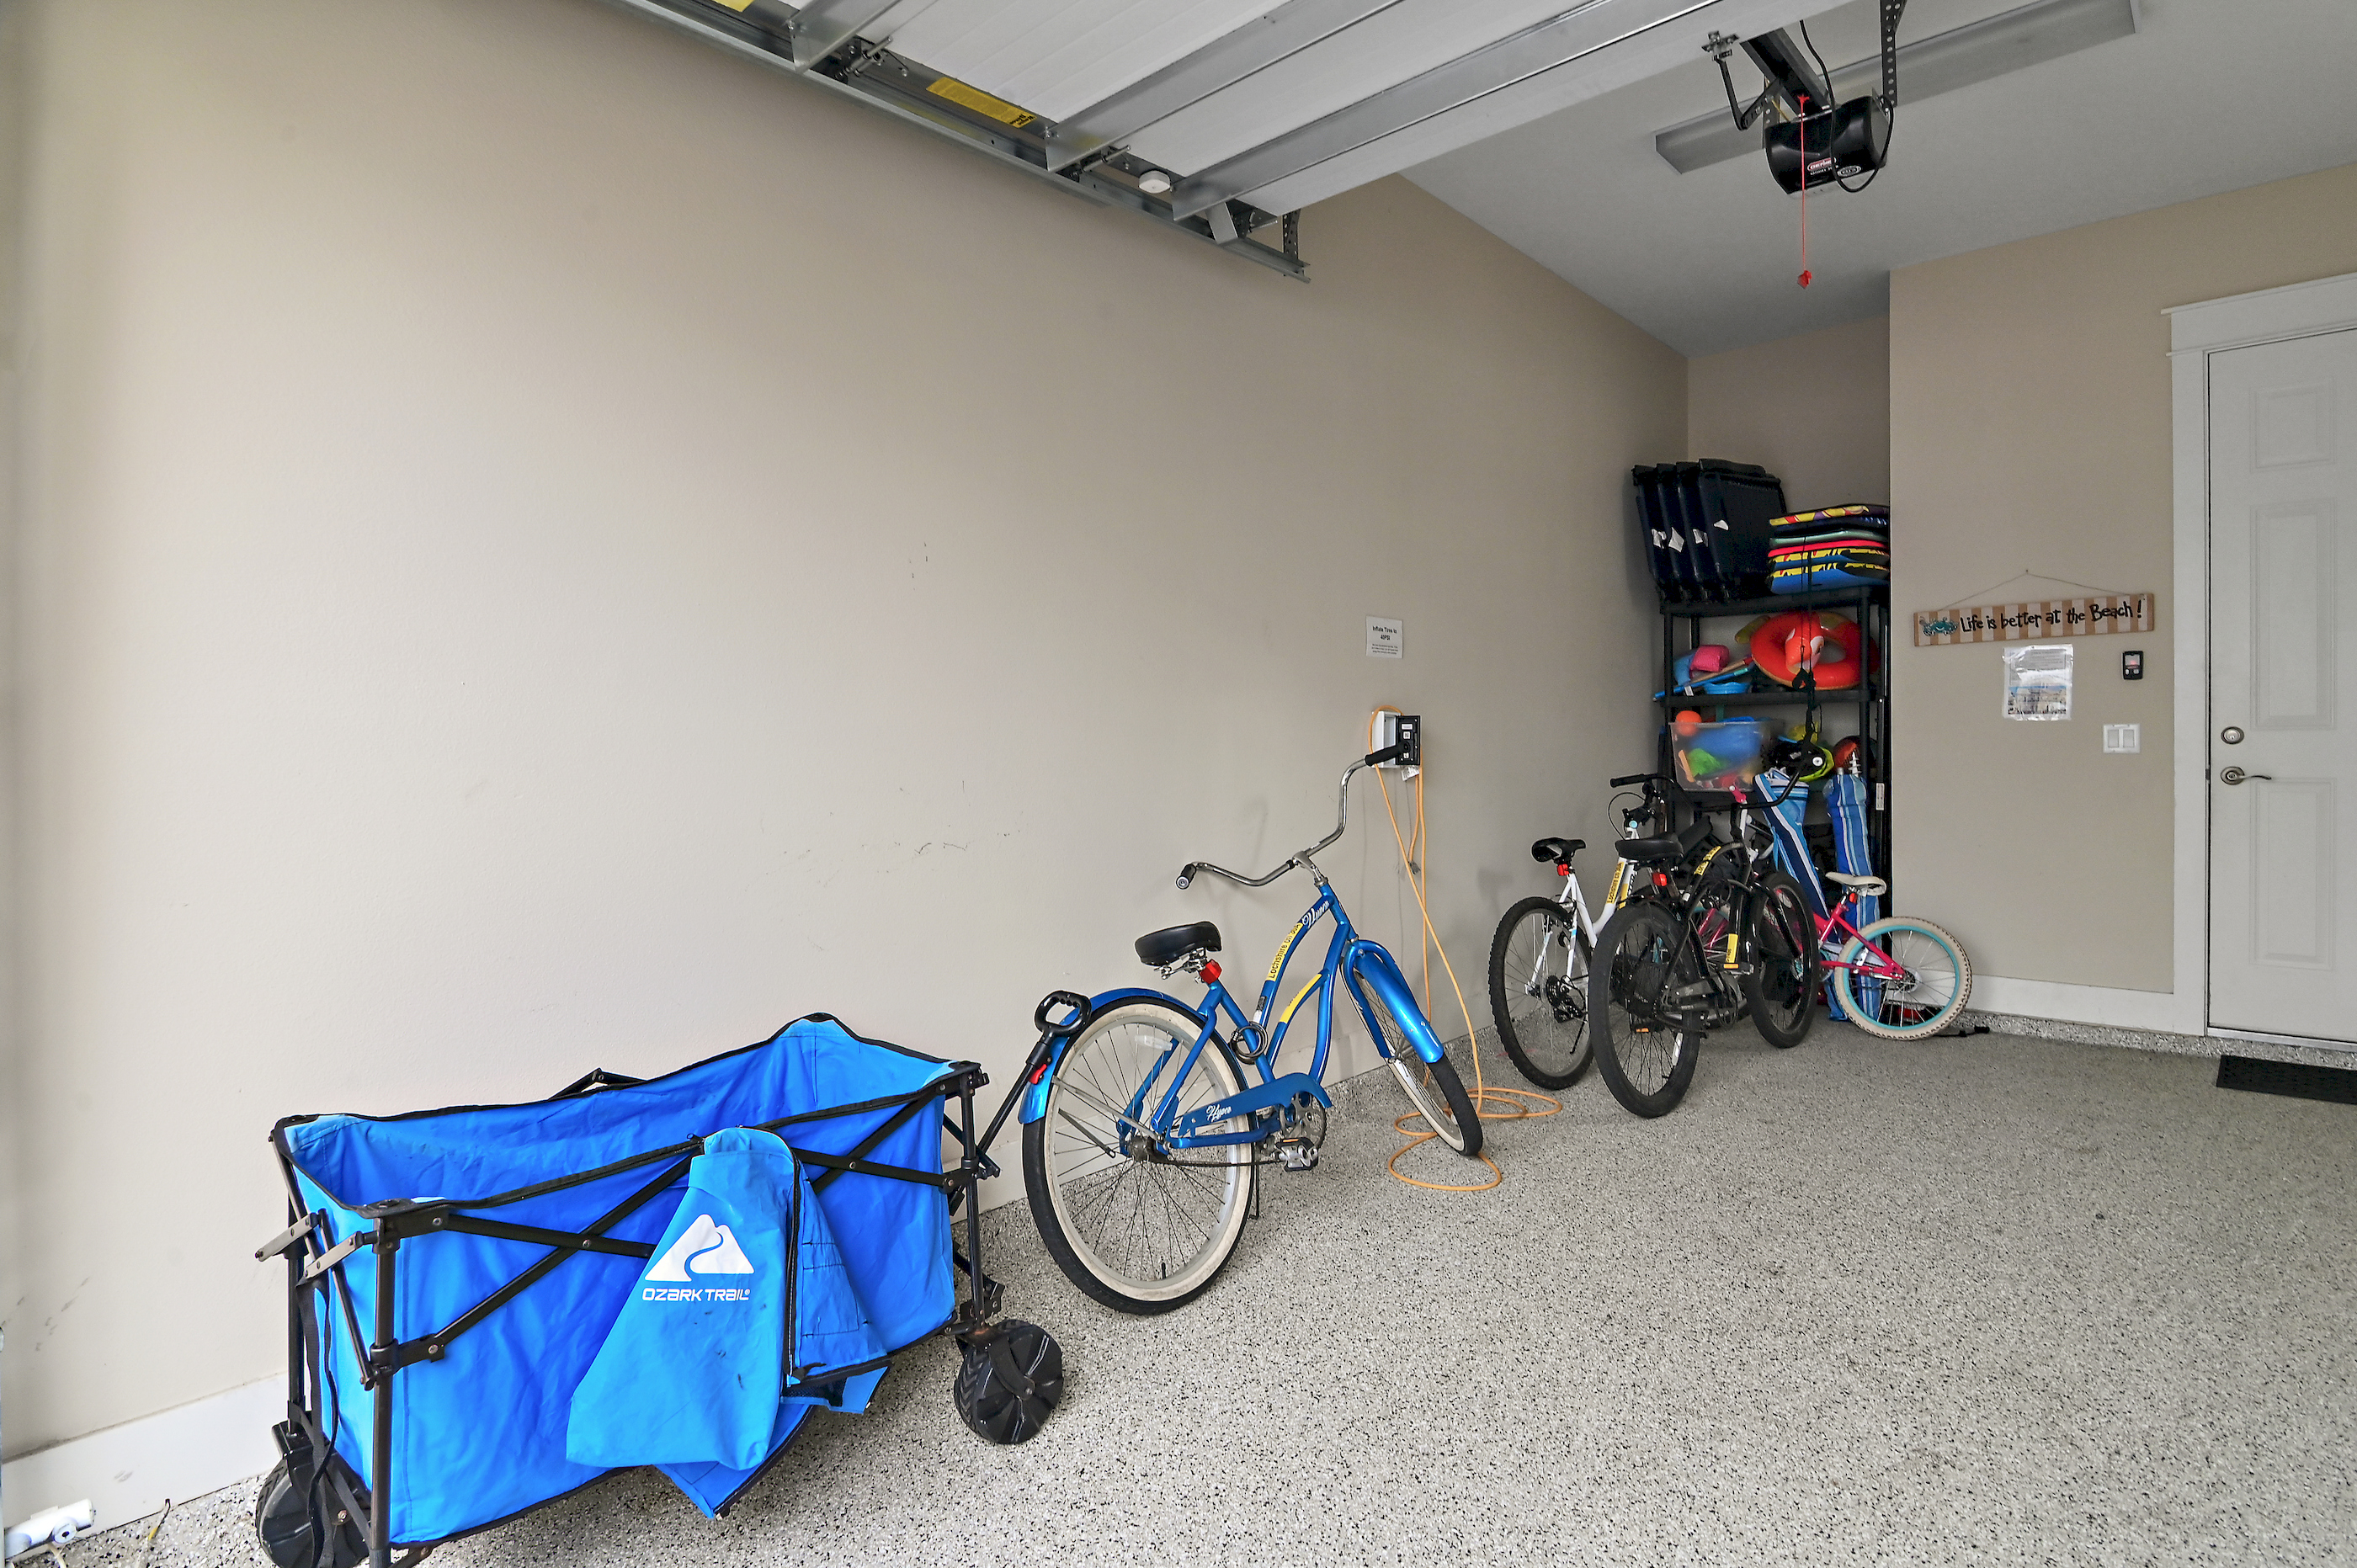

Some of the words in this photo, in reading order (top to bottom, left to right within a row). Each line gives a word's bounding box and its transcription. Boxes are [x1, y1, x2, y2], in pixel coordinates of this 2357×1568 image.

[1961, 614, 1984, 632] Life
[1986, 615, 1998, 630] is
[2000, 611, 2042, 630] better
[2045, 609, 2062, 625] at
[2066, 607, 2086, 625] the
[641, 1288, 704, 1302] OZARK
[705, 1289, 749, 1302] TRAIL
